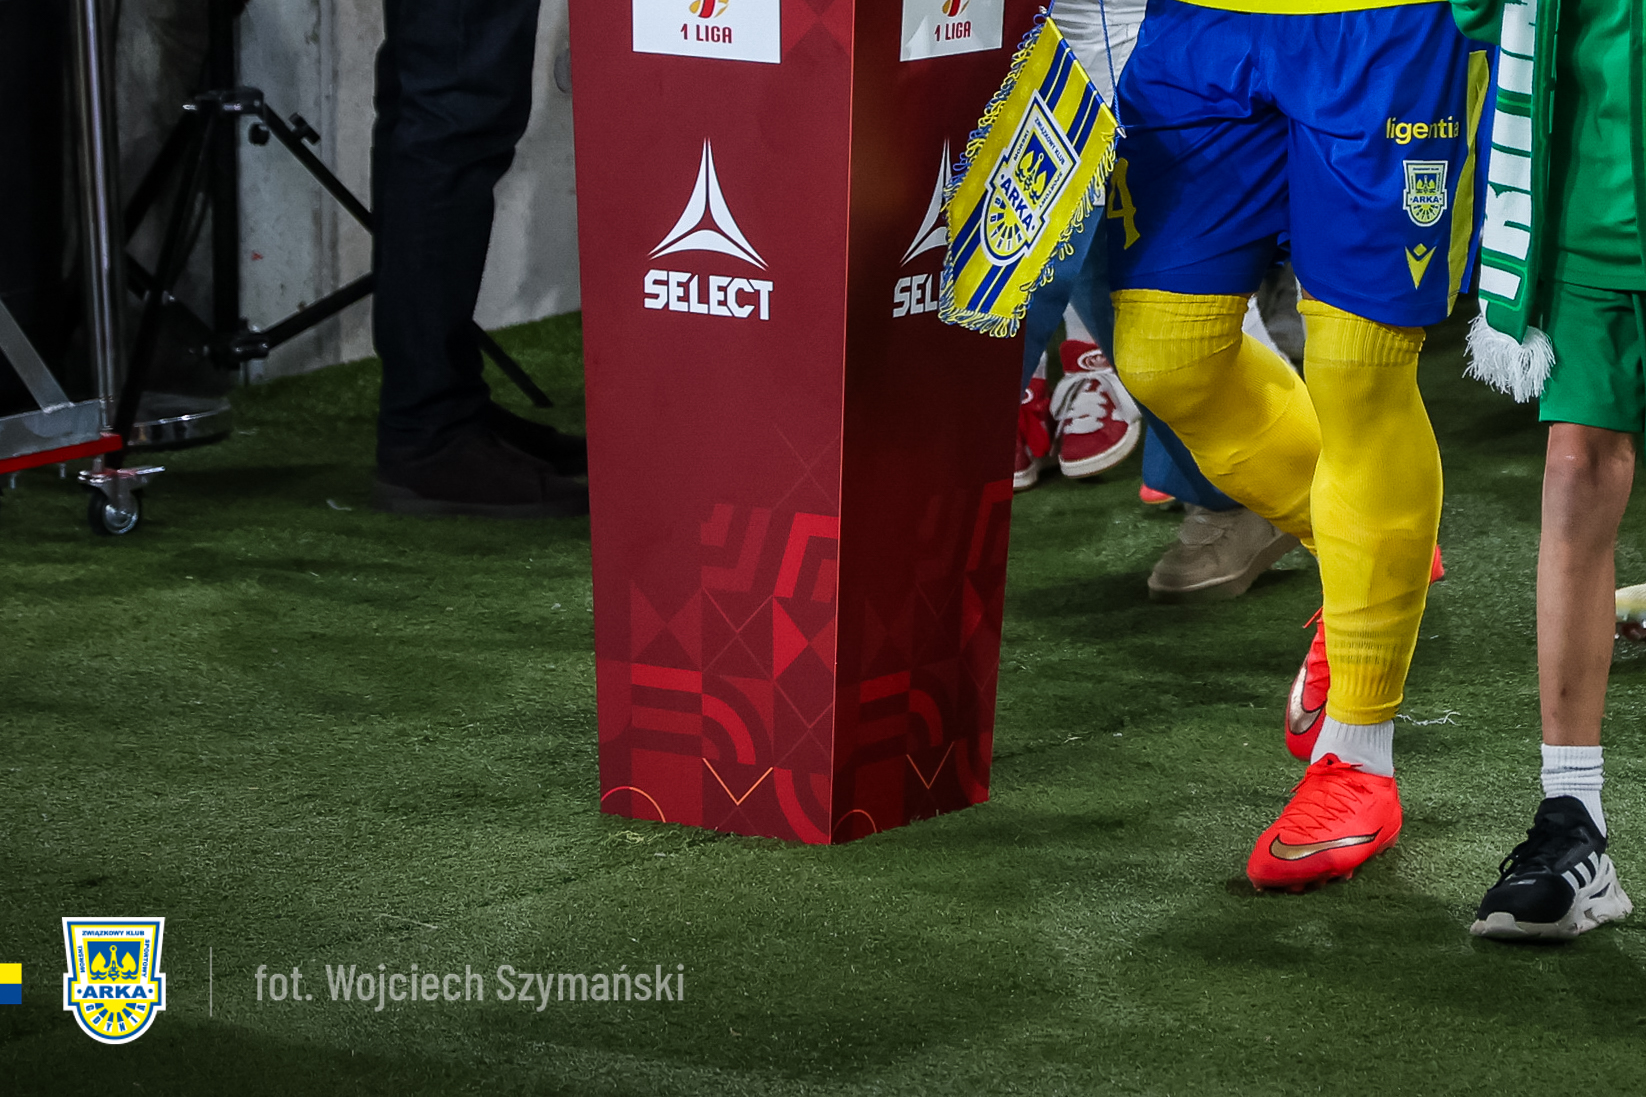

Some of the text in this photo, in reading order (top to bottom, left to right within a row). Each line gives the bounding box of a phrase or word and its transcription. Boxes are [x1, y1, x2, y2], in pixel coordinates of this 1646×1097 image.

[680, 23, 733, 44] 1 LIGA
[934, 21, 971, 42] 1 LIGA
[1000, 178, 1033, 232] ARKA
[643, 268, 774, 321] SELECT
